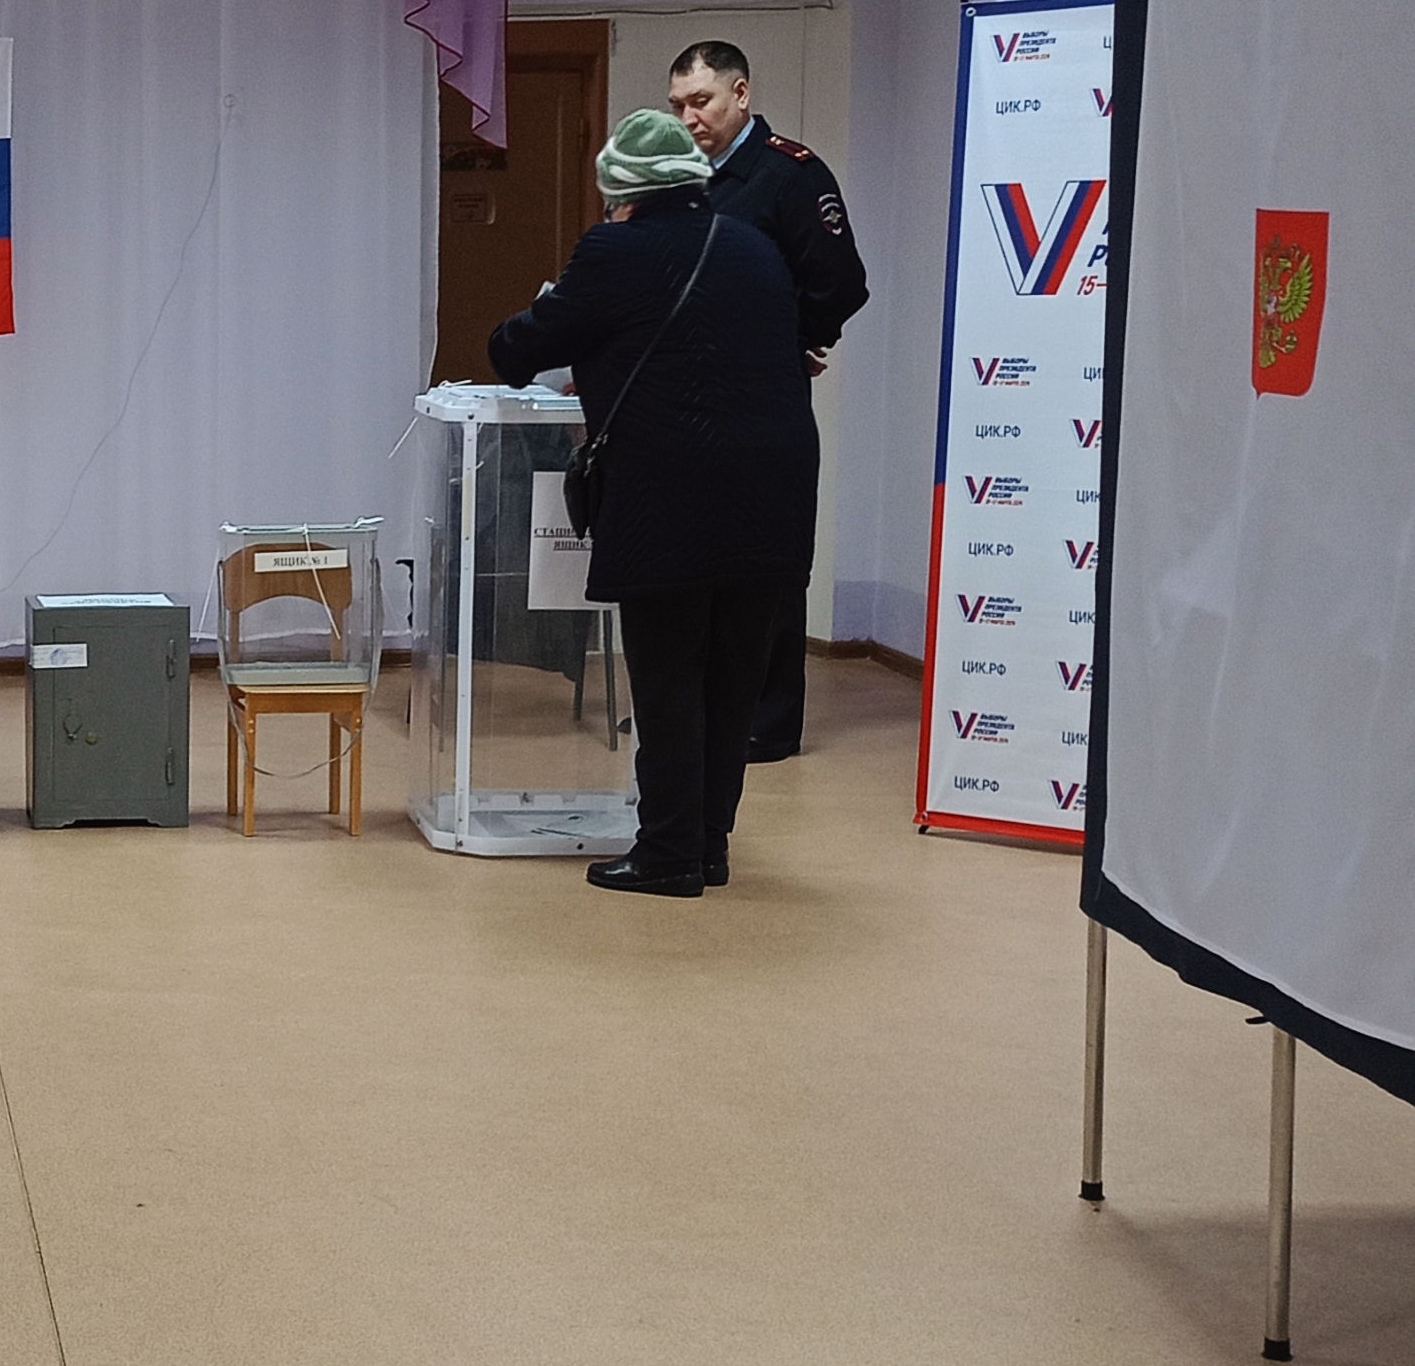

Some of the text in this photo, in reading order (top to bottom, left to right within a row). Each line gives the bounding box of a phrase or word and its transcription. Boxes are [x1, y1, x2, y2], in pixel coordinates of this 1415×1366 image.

[996, 99, 1041, 115] ЦИК.РФ
[975, 425, 1021, 439] ЦИК.РФ
[968, 542, 1014, 556] ЦИК.РФ
[273, 557, 306, 567] ЯЩИК
[1069, 610, 1095, 625] ЦИК
[962, 660, 1006, 676] ЦИК.РФ
[1062, 731, 1088, 746] ЦИК
[954, 776, 999, 792] ЦИК.РФ
